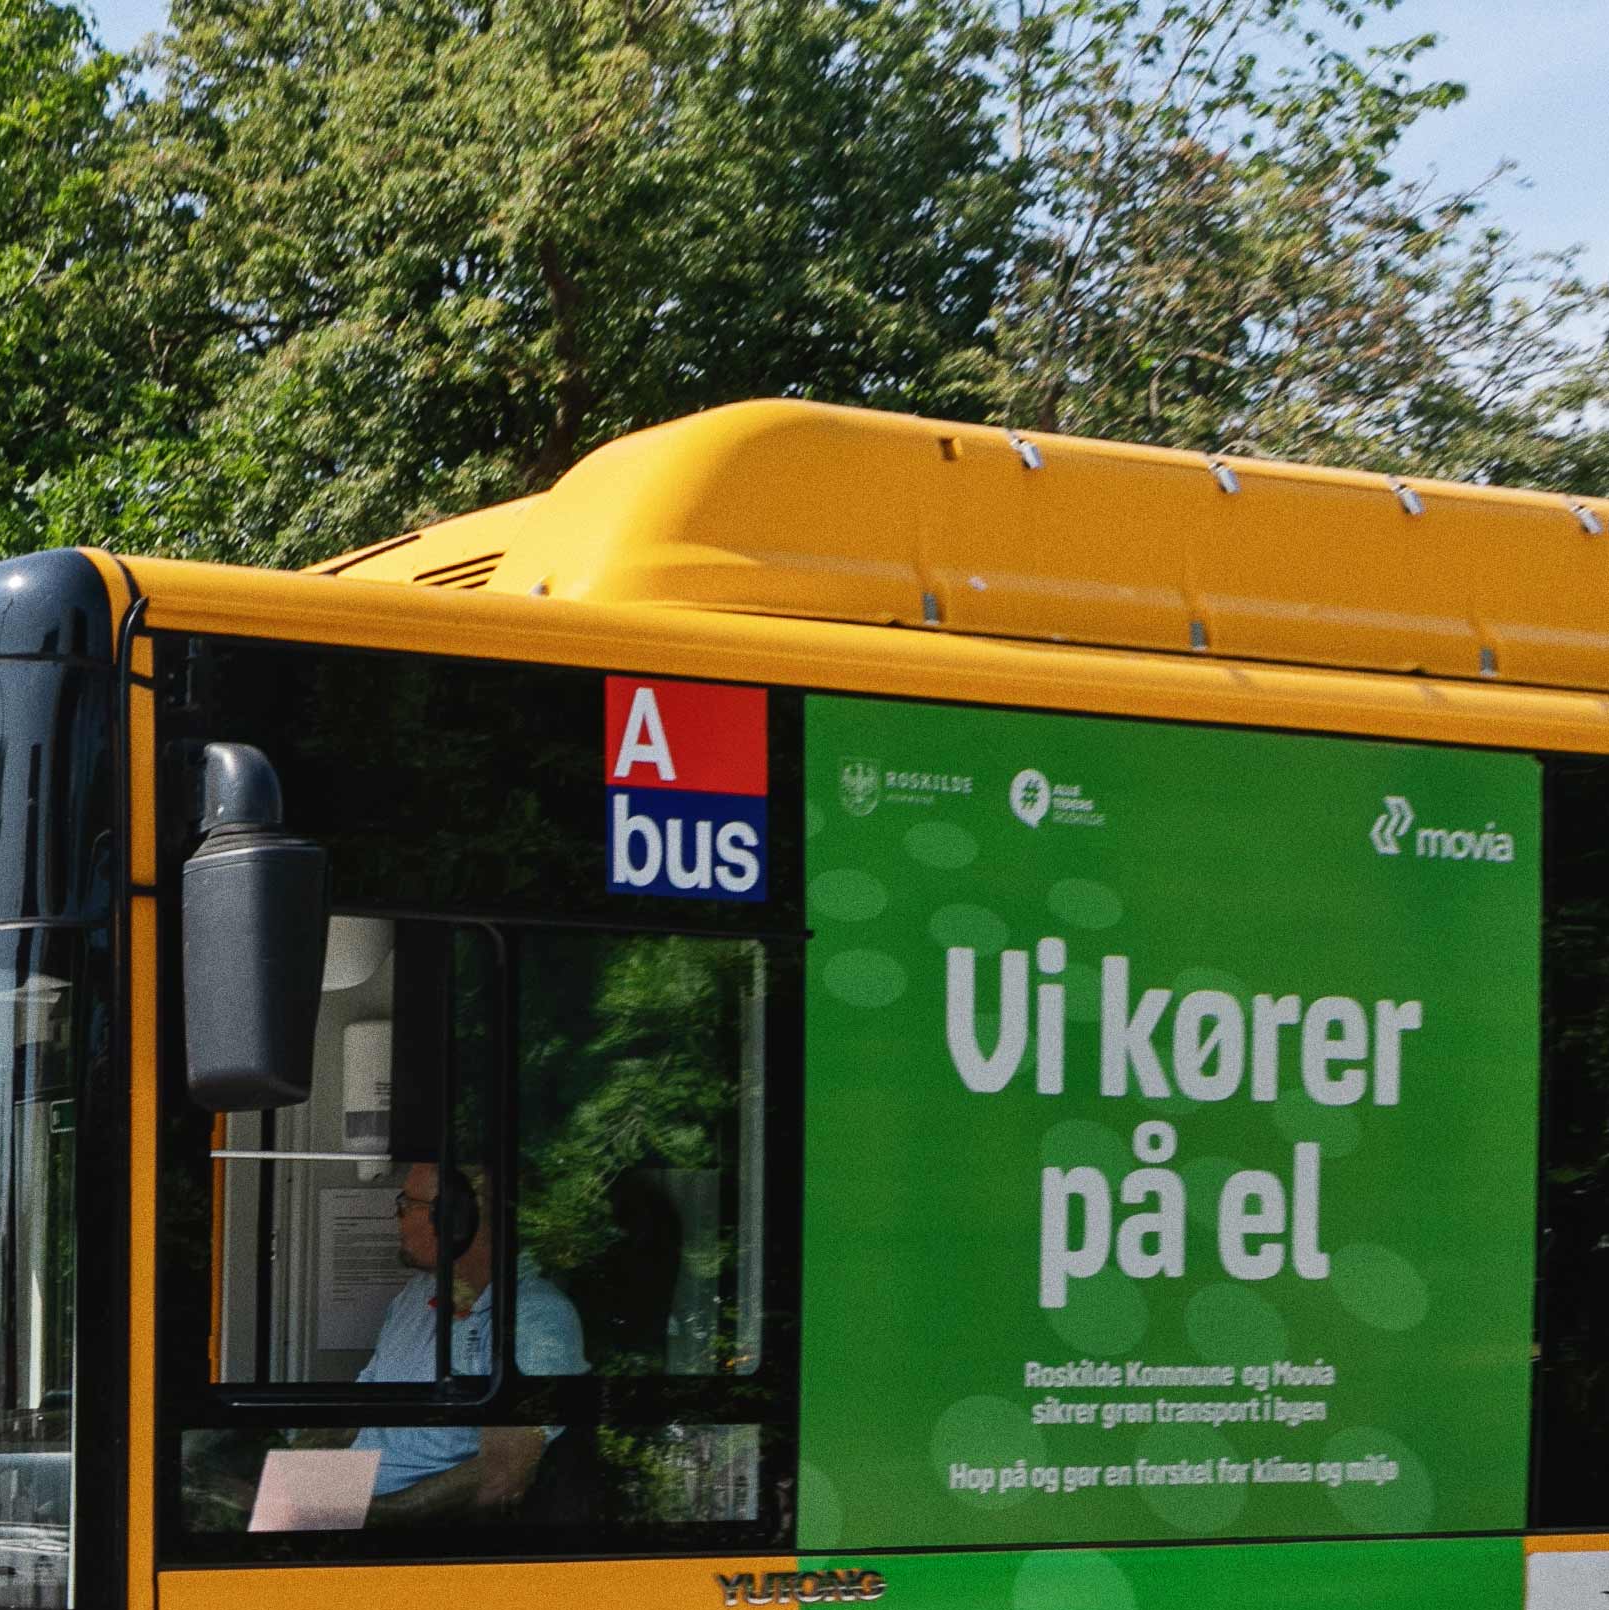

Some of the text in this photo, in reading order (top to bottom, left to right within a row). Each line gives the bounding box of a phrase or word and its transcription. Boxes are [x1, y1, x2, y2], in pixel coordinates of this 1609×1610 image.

[613, 687, 677, 781] A
[885, 772, 974, 794] ROSKILDE
[613, 794, 759, 892] bus
[1416, 821, 1515, 862] movia
[946, 936, 1422, 1106] Vi kører
[1039, 1120, 1331, 1308] på el
[1025, 1359, 1335, 1391] Roskilde Kommune og Movia
[1032, 1394, 1327, 1429] sikrer grøn transport i byen
[949, 1463, 995, 1494] Hop
[998, 1459, 1027, 1493] på
[1031, 1466, 1059, 1493] og
[1063, 1466, 1102, 1493] gør
[1104, 1465, 1131, 1487] en
[1135, 1458, 1214, 1486] forskel
[1217, 1457, 1251, 1484] for
[1252, 1456, 1313, 1483] klima
[1316, 1462, 1341, 1487] og
[716, 1570, 887, 1606] YUTONG
